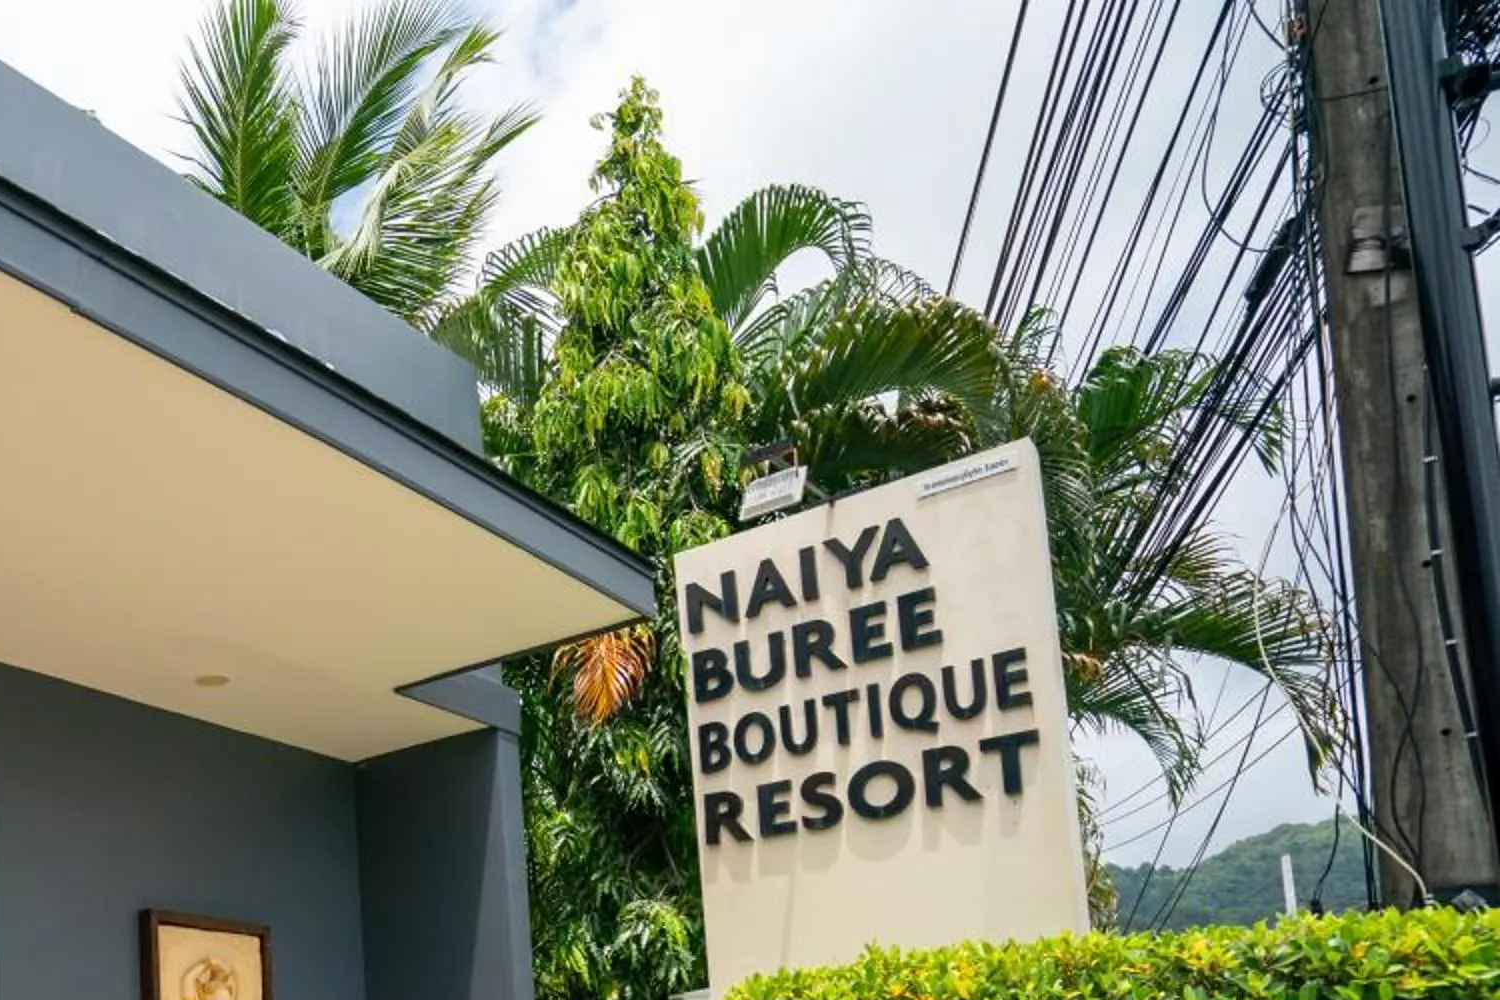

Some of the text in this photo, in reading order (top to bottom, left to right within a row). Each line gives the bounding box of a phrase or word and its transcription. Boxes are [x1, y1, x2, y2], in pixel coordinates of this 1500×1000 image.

[685, 517, 930, 634] NAIYA
[691, 587, 944, 704] BUREE
[698, 648, 1033, 774] BOUTIQUE
[704, 728, 1040, 845] RESORT
